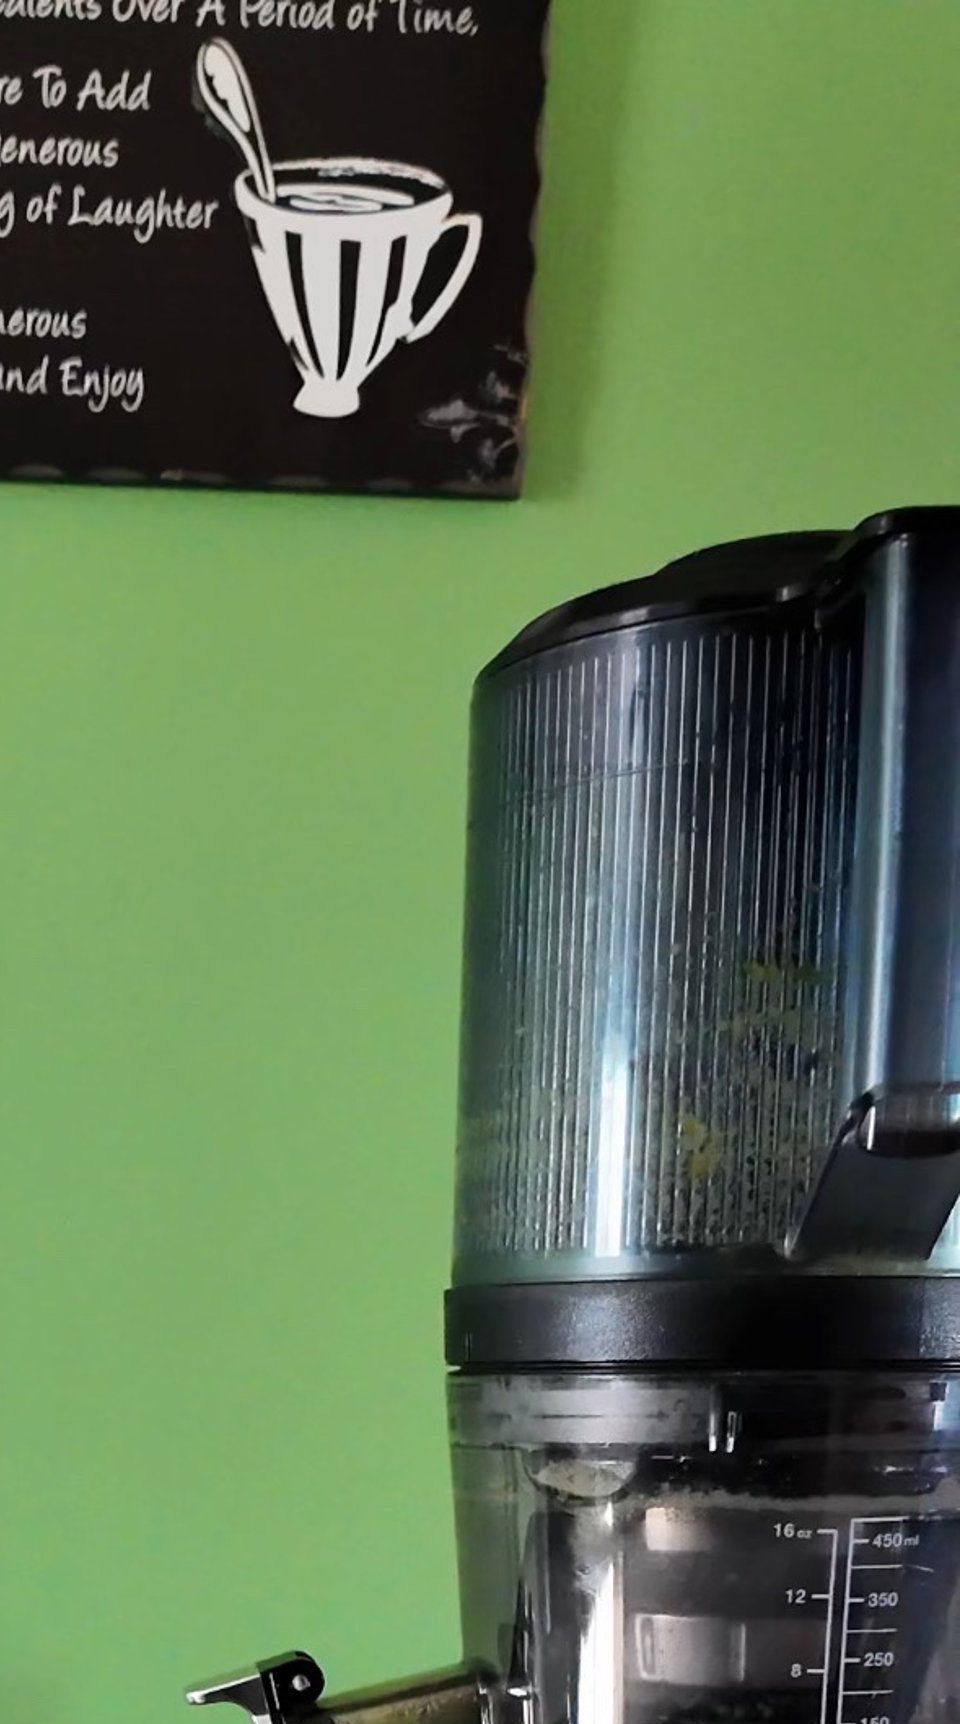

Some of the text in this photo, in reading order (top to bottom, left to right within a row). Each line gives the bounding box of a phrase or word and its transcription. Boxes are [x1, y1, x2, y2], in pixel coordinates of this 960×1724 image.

[112, 0, 186, 23] Over
[195, 0, 226, 28] A
[239, 0, 336, 31] Period
[346, 0, 378, 32] of
[389, 0, 478, 36] Time,
[32, 64, 67, 109] To
[76, 69, 152, 112] Add
[26, 183, 62, 225] of
[67, 184, 219, 244] Laughter
[58, 357, 145, 413] Enjoy
[785, 1589, 806, 1604] 12
[868, 1591, 899, 1608] 350
[790, 1663, 802, 1678] 8
[863, 1651, 894, 1667] 250
